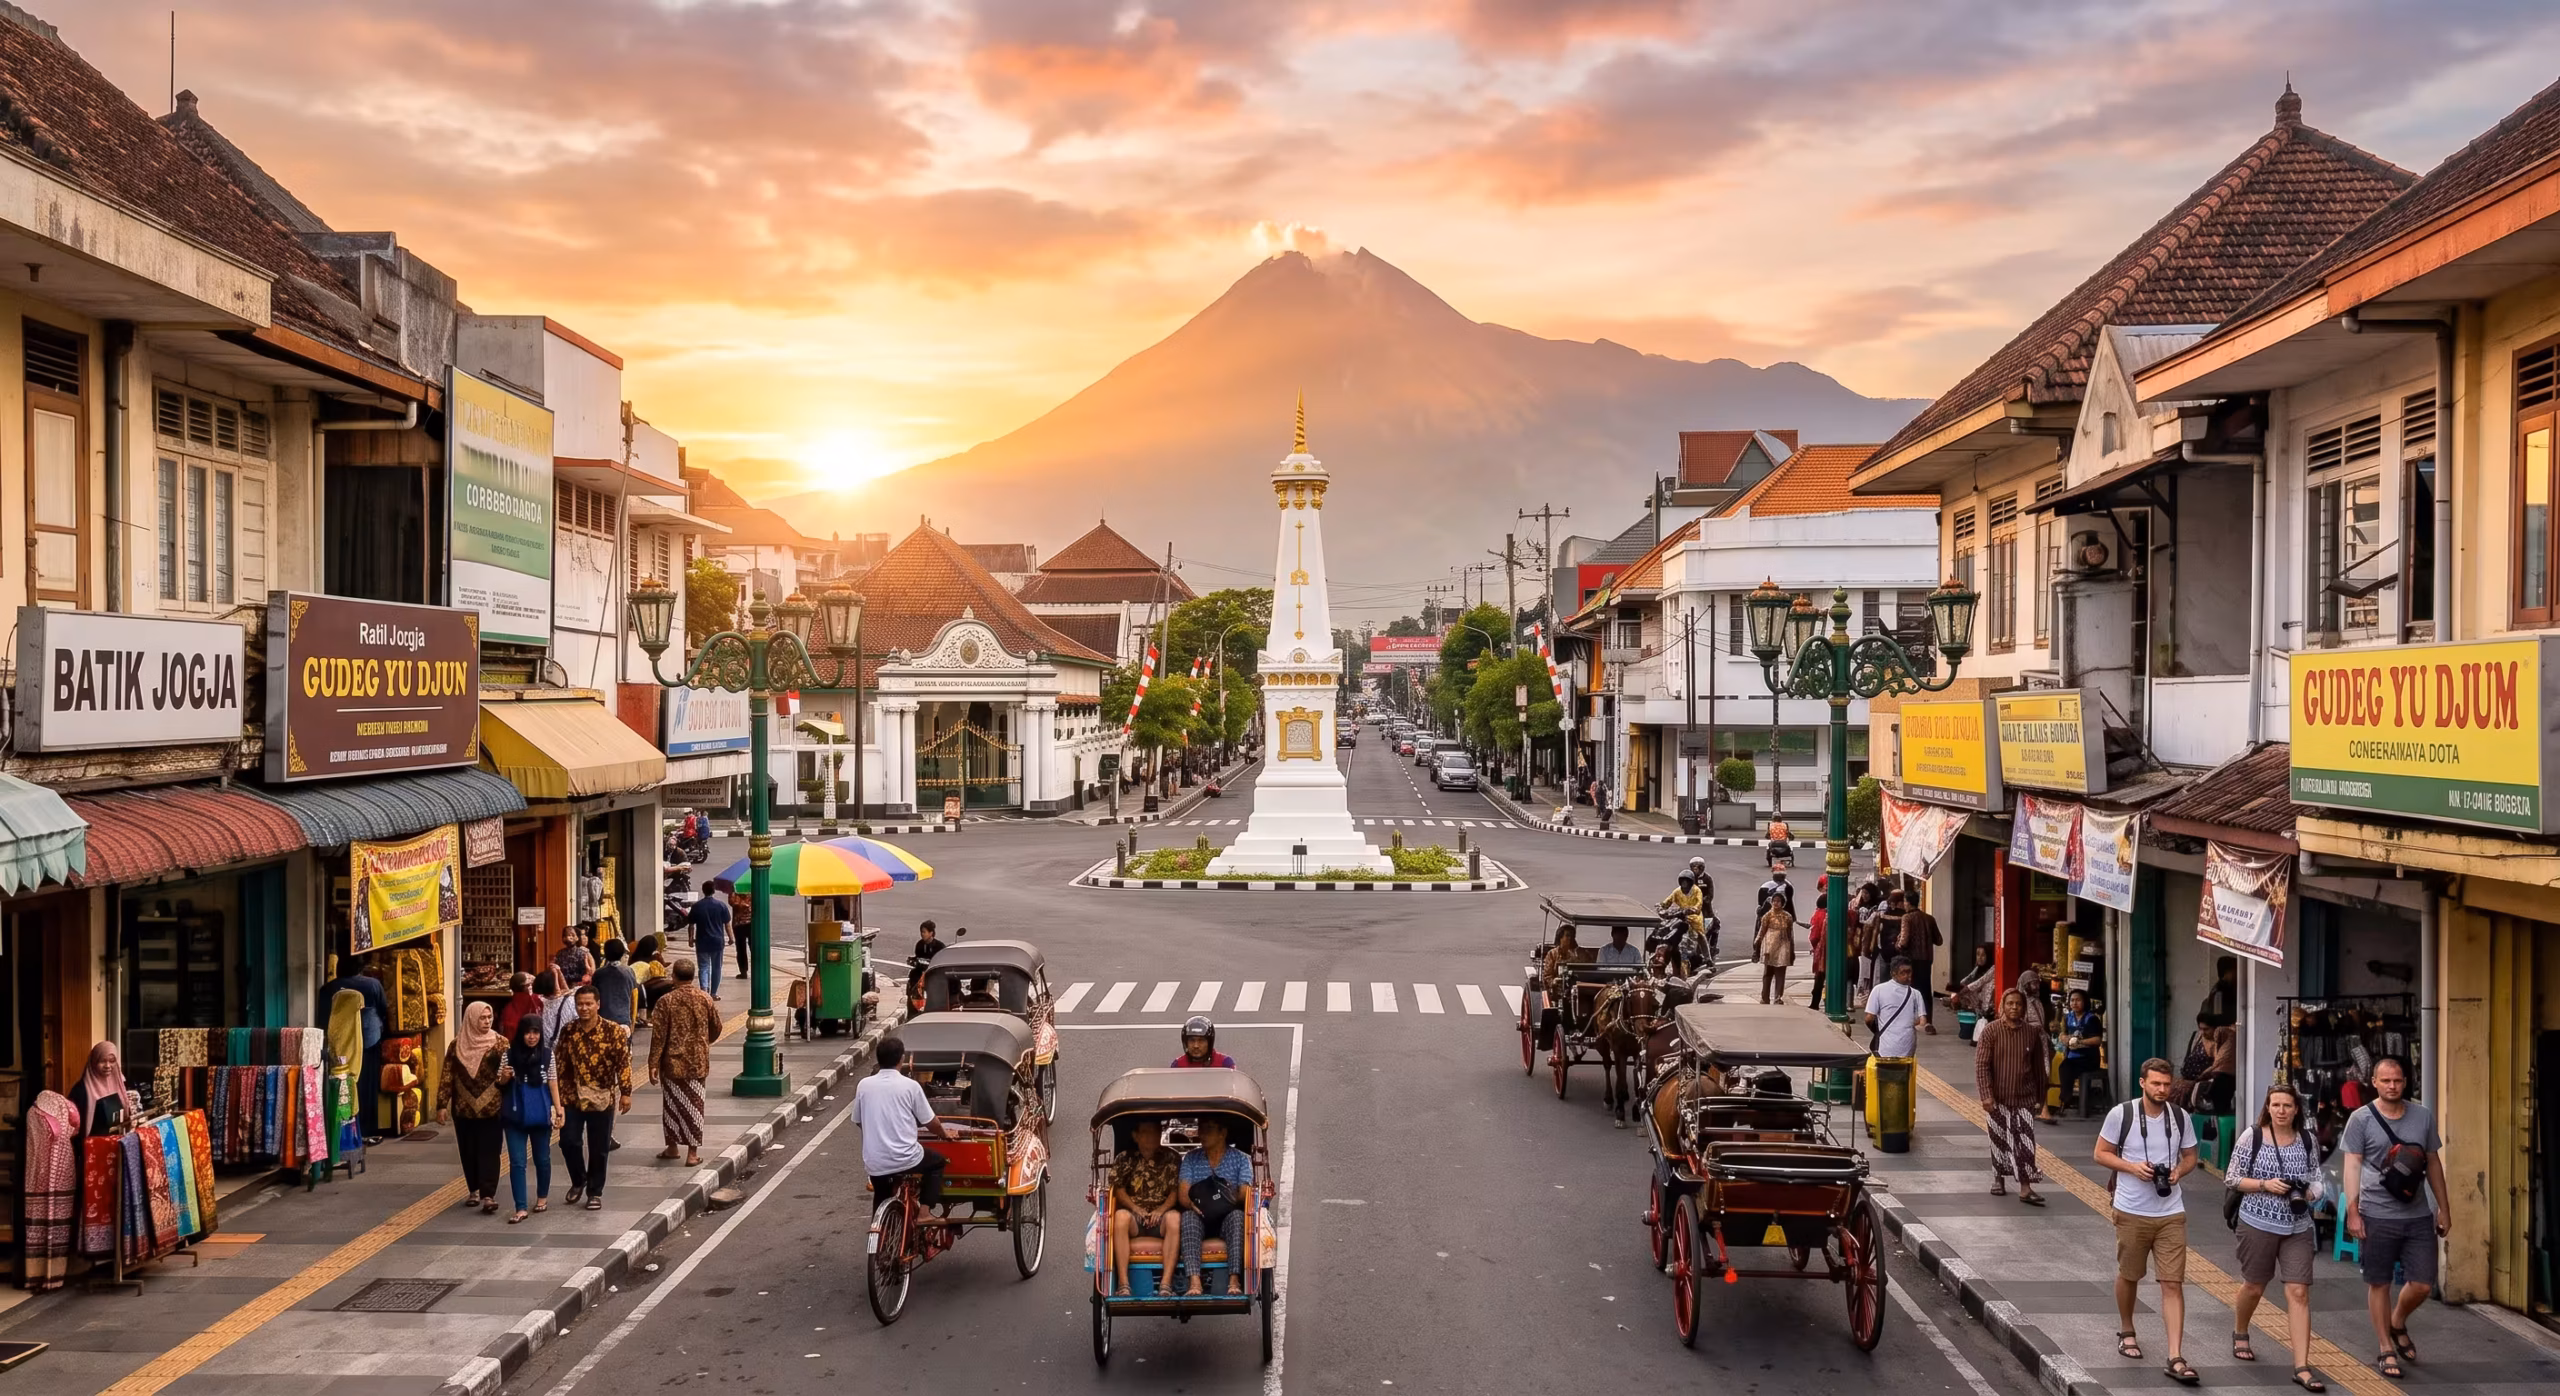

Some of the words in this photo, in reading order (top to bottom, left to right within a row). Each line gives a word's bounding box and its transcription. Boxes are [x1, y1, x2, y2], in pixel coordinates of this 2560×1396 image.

[359, 622, 387, 645] Ratil
[53, 648, 145, 712] BATIK
[152, 652, 237, 711] JOGJA
[303, 656, 380, 698] GUDEG
[384, 660, 413, 697] YU
[416, 660, 468, 696] DJUN
[2303, 667, 2384, 727] GUDEG
[2389, 664, 2428, 729] YU
[2434, 660, 2519, 730] DJUM
[2429, 743, 2460, 764] DOTA
